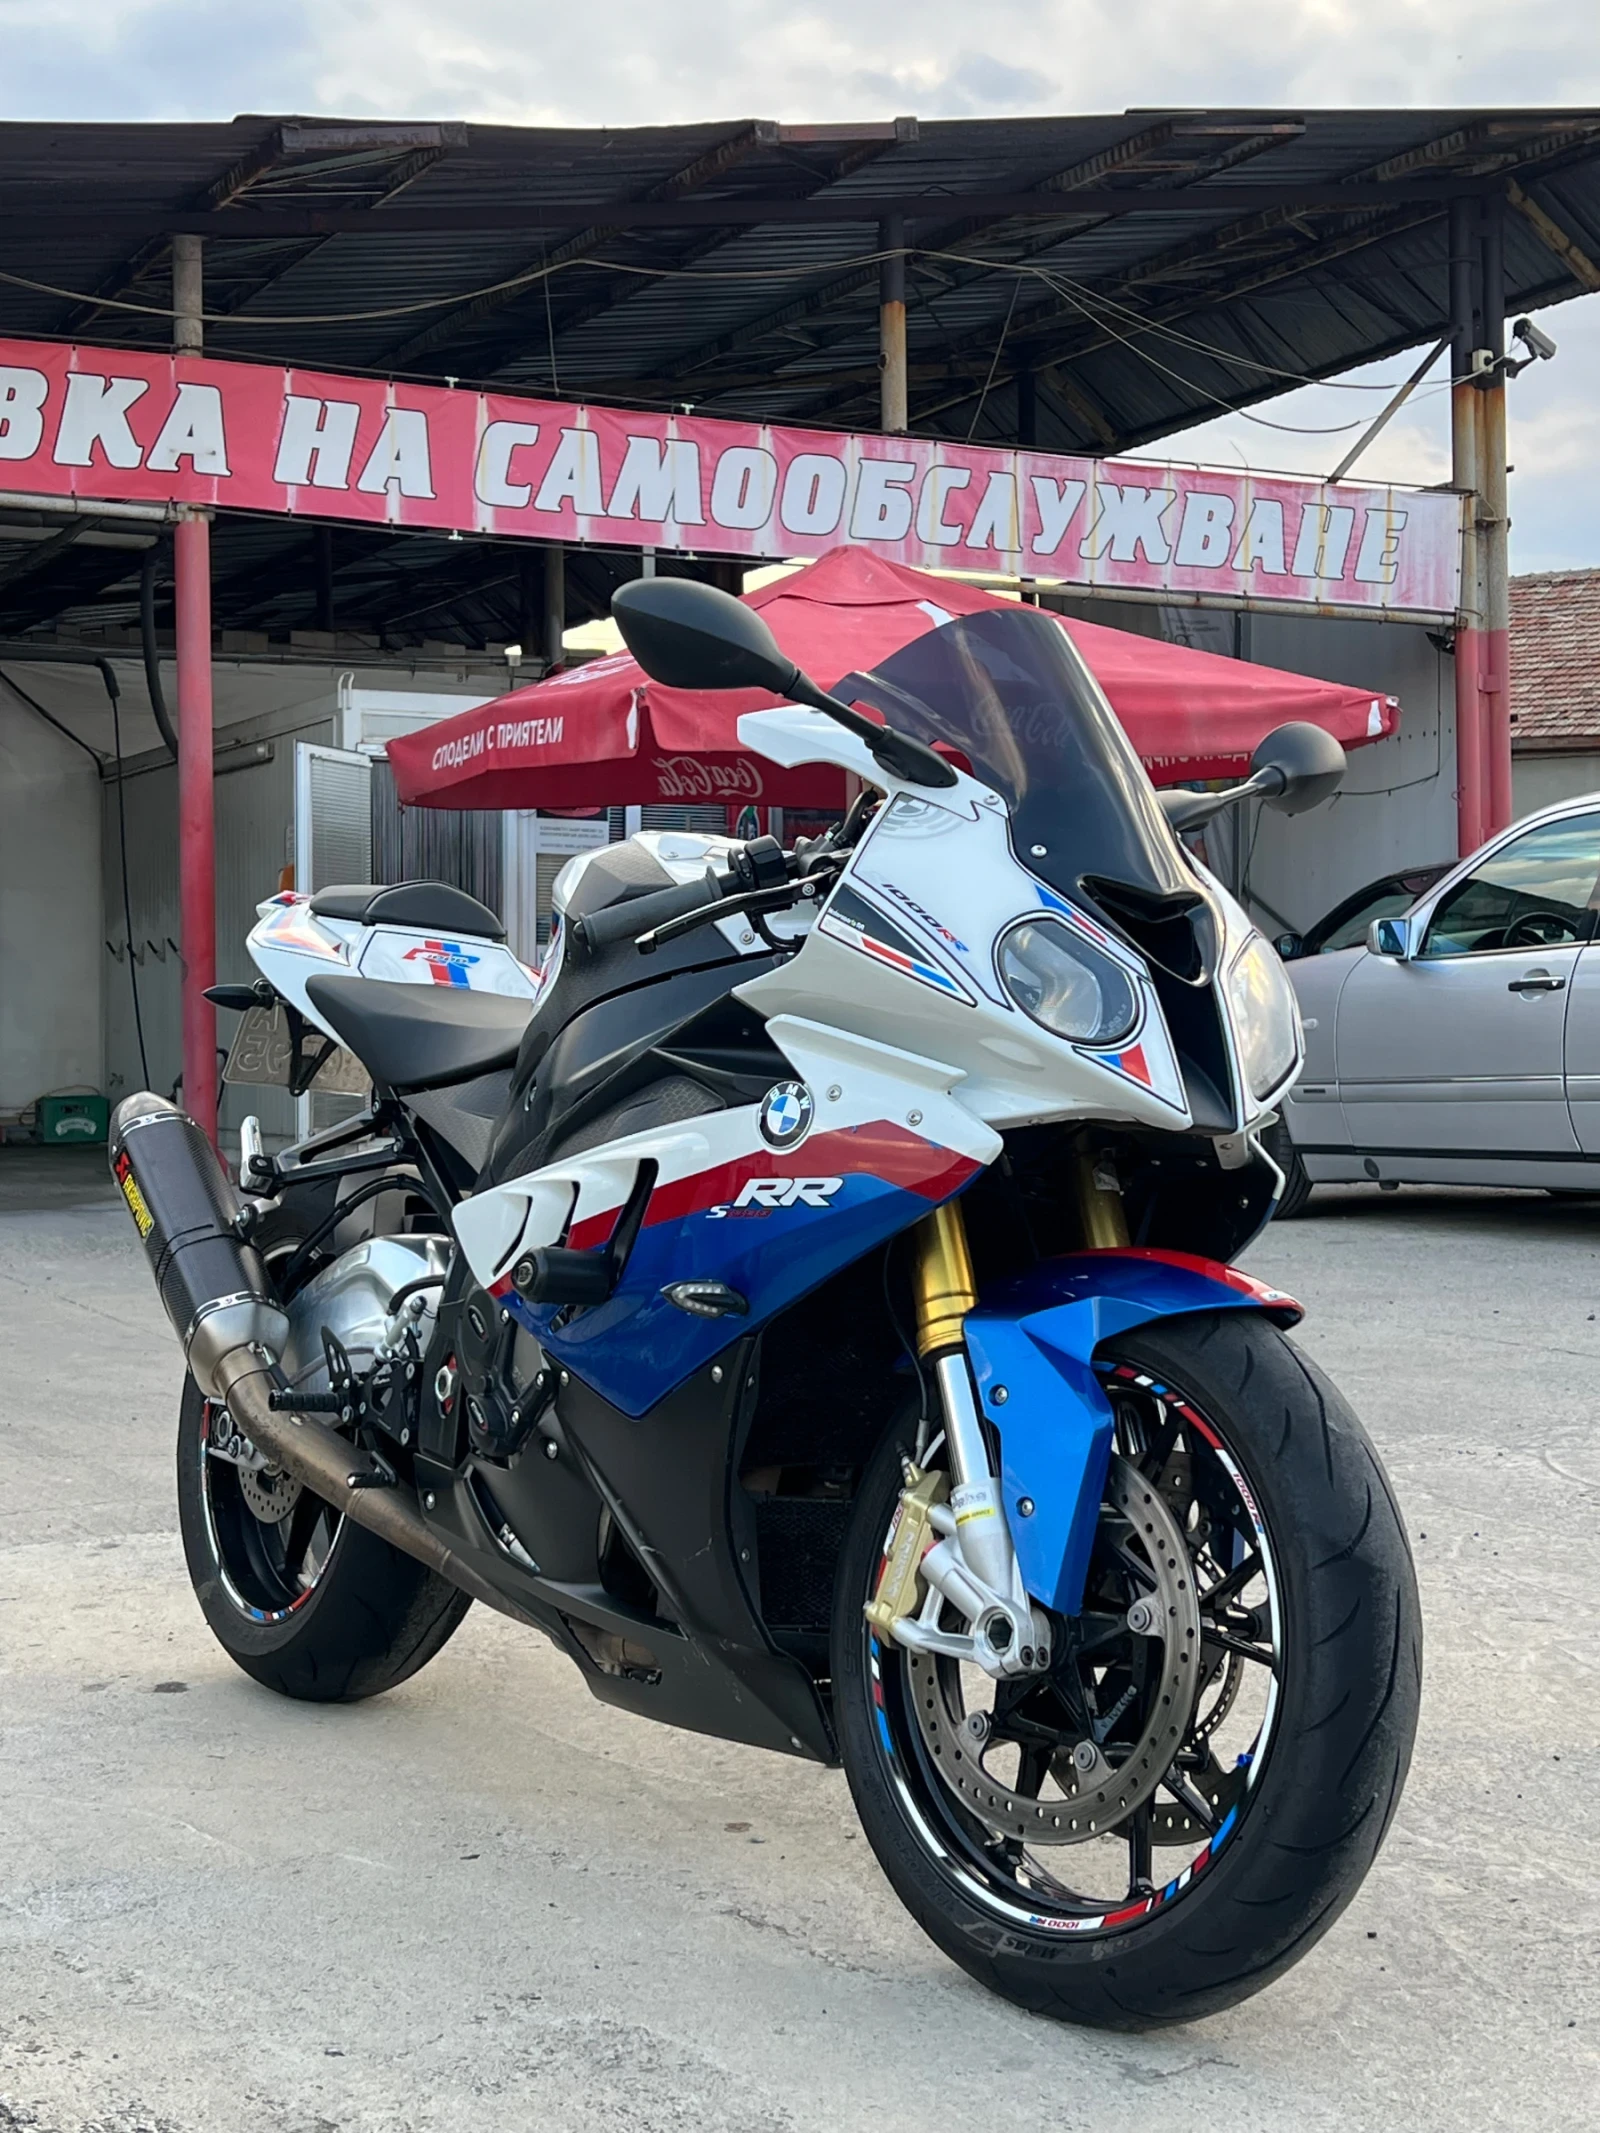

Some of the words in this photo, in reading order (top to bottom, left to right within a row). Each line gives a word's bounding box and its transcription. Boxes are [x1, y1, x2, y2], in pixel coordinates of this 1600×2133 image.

[273, 393, 437, 500] НА
[474, 420, 1409, 585] САМООБСЛУЖВАНЕ
[432, 729, 485, 771] СПОДЕЛИ
[486, 725, 496, 750] С
[497, 716, 564, 749] ПРИЯТЕЛИ
[769, 1083, 811, 1110] BMW
[733, 1177, 844, 1207] RR
